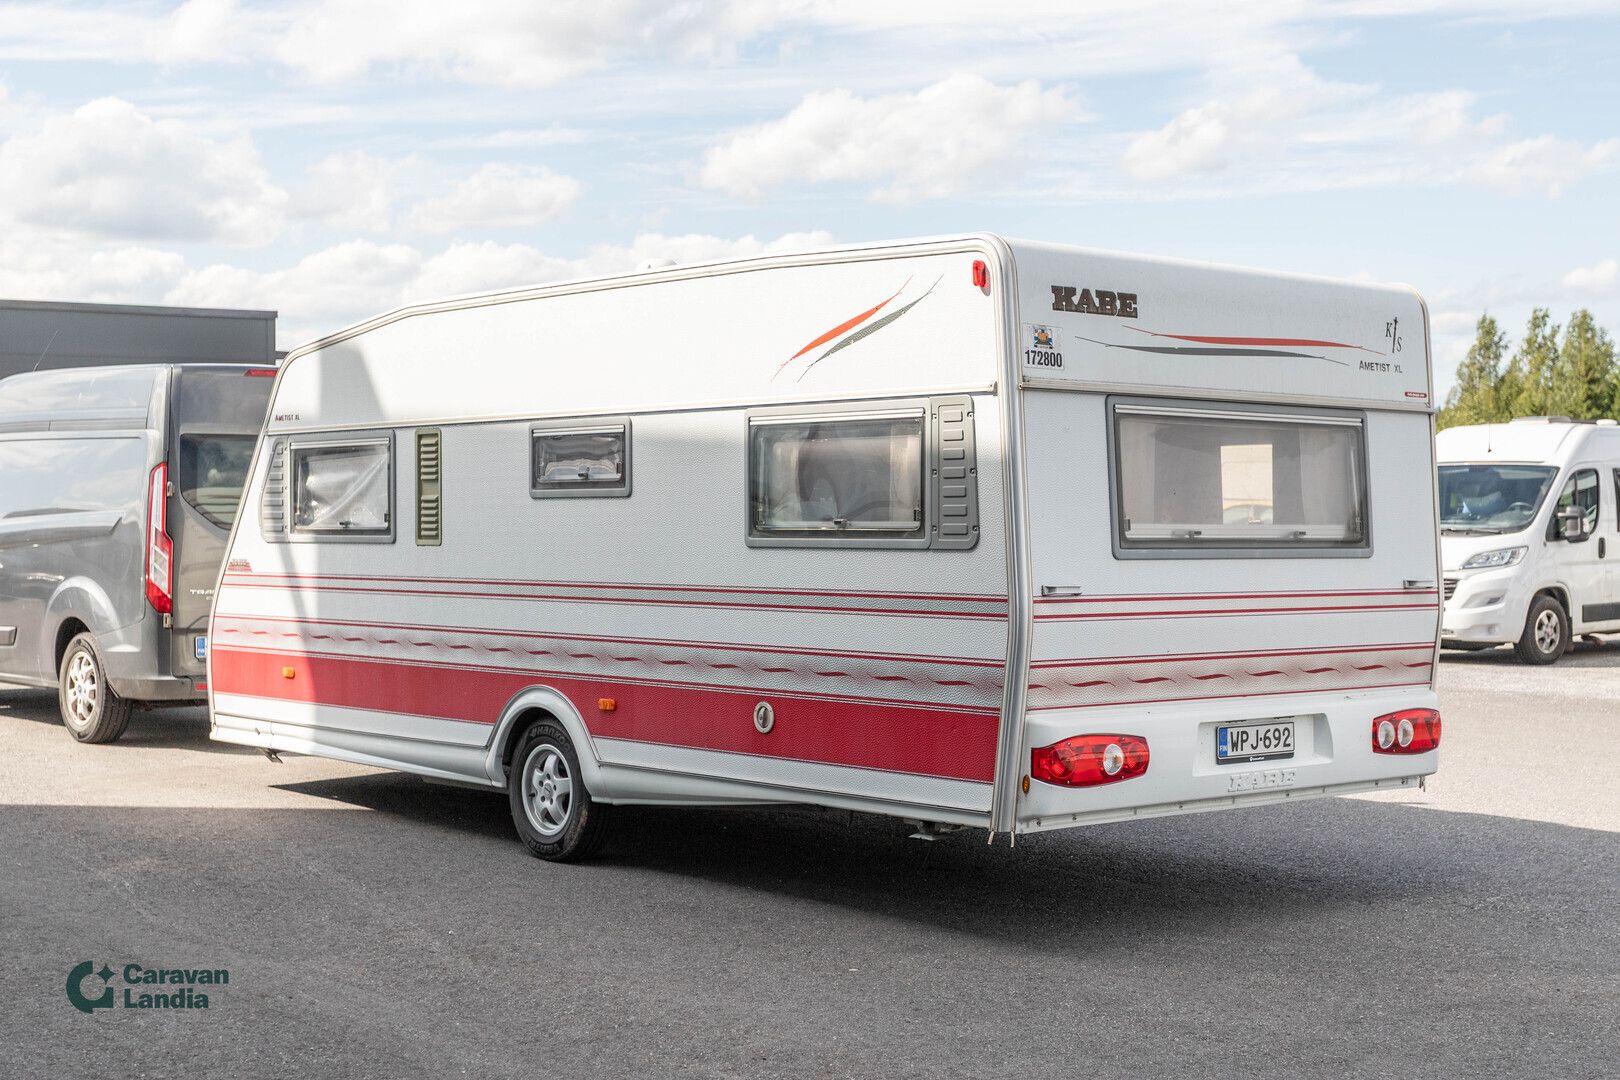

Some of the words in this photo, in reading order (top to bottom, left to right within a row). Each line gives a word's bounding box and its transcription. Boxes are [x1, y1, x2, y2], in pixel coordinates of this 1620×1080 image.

[1051, 285, 1138, 318] KABE
[1025, 350, 1062, 367] 172800
[1359, 360, 1391, 372] AMETIST
[1394, 365, 1403, 373] XL
[1230, 727, 1291, 752] WPJ-692
